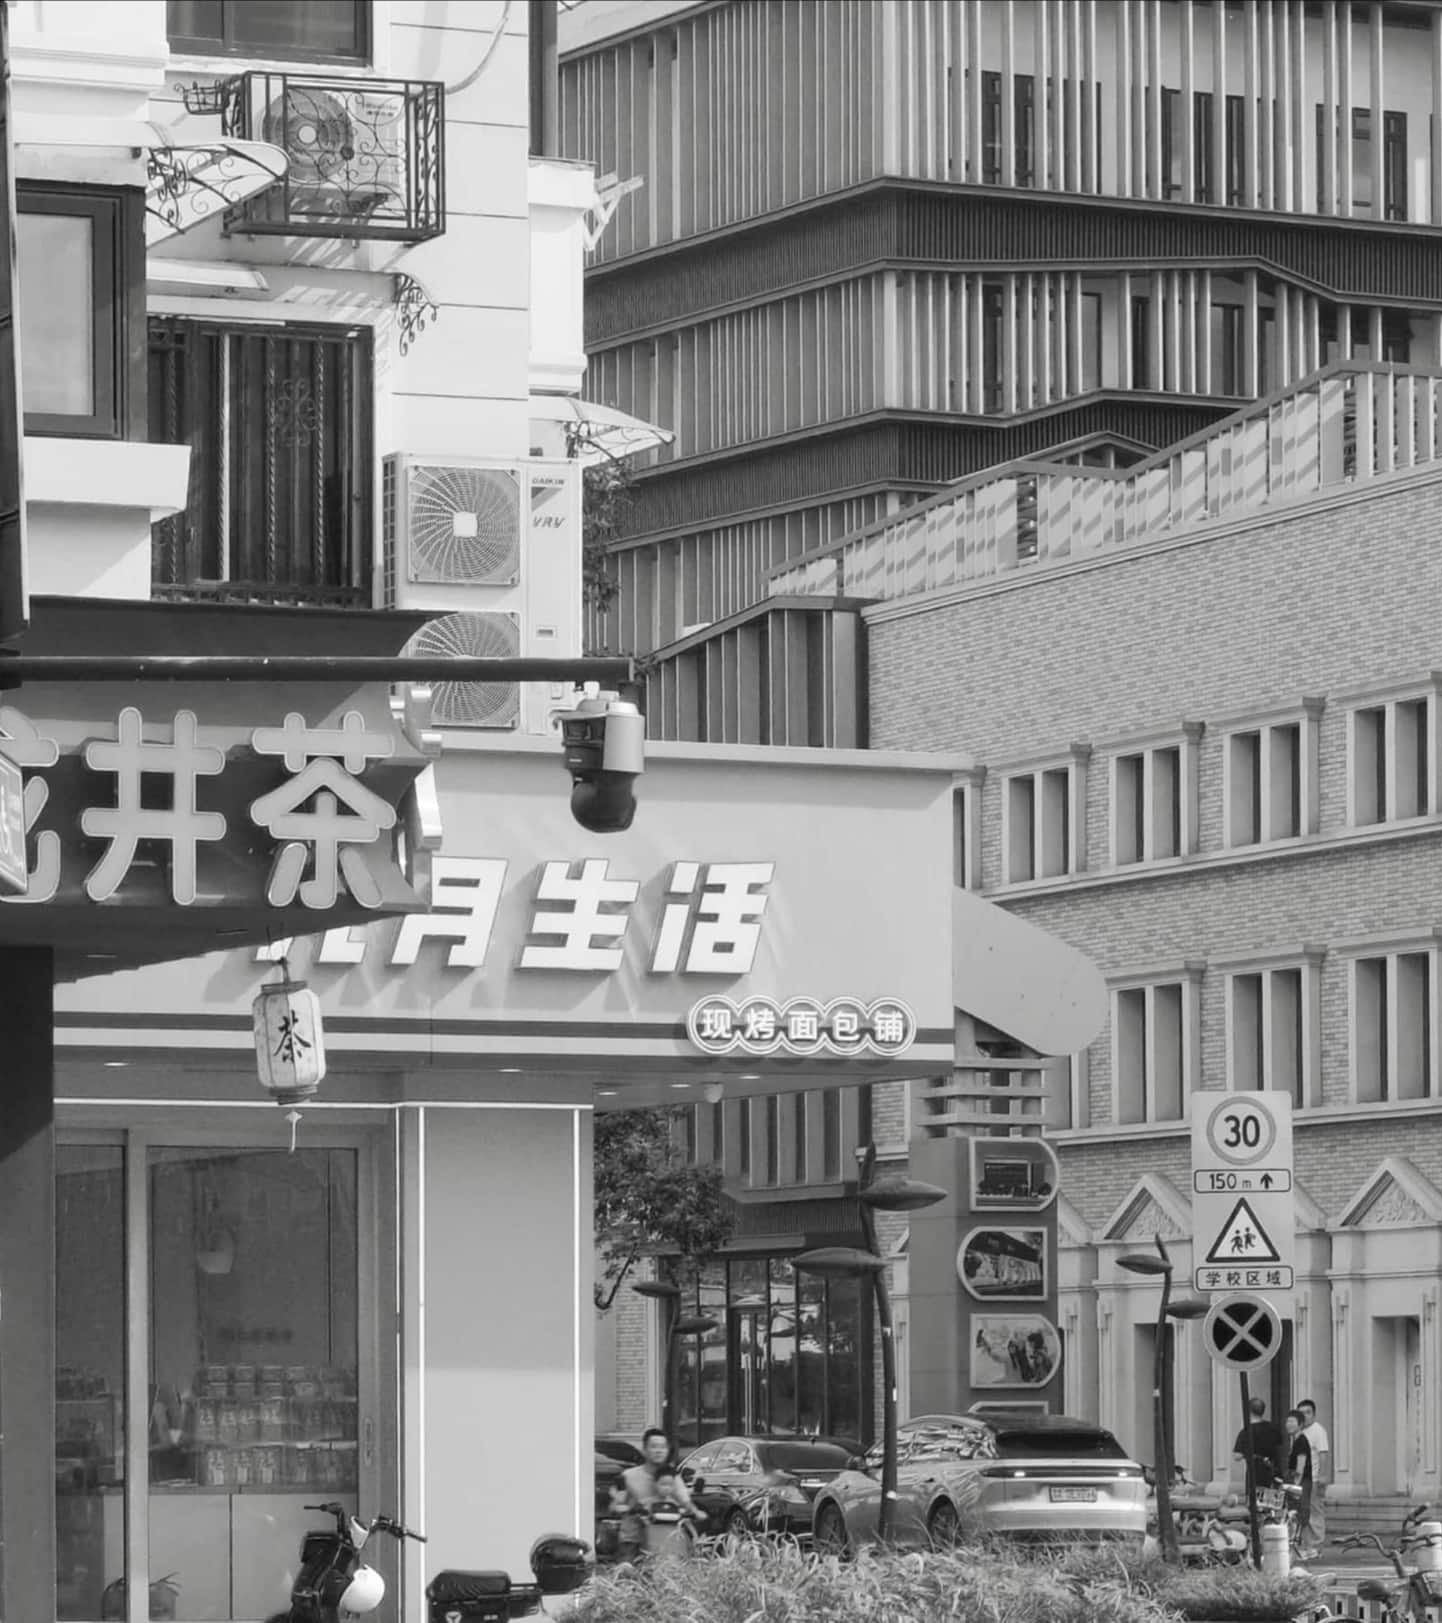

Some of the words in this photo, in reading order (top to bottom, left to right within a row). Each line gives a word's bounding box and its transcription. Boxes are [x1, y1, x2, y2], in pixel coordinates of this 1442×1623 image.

[533, 515, 565, 528] VRV
[255, 856, 776, 974] 月生活
[273, 1011, 313, 1066] 茶
[700, 1008, 904, 1043] 现烤面包铺
[1223, 1114, 1261, 1148] 30
[1209, 1173, 1238, 1190] 150
[1205, 1270, 1282, 1287] 学校区域
